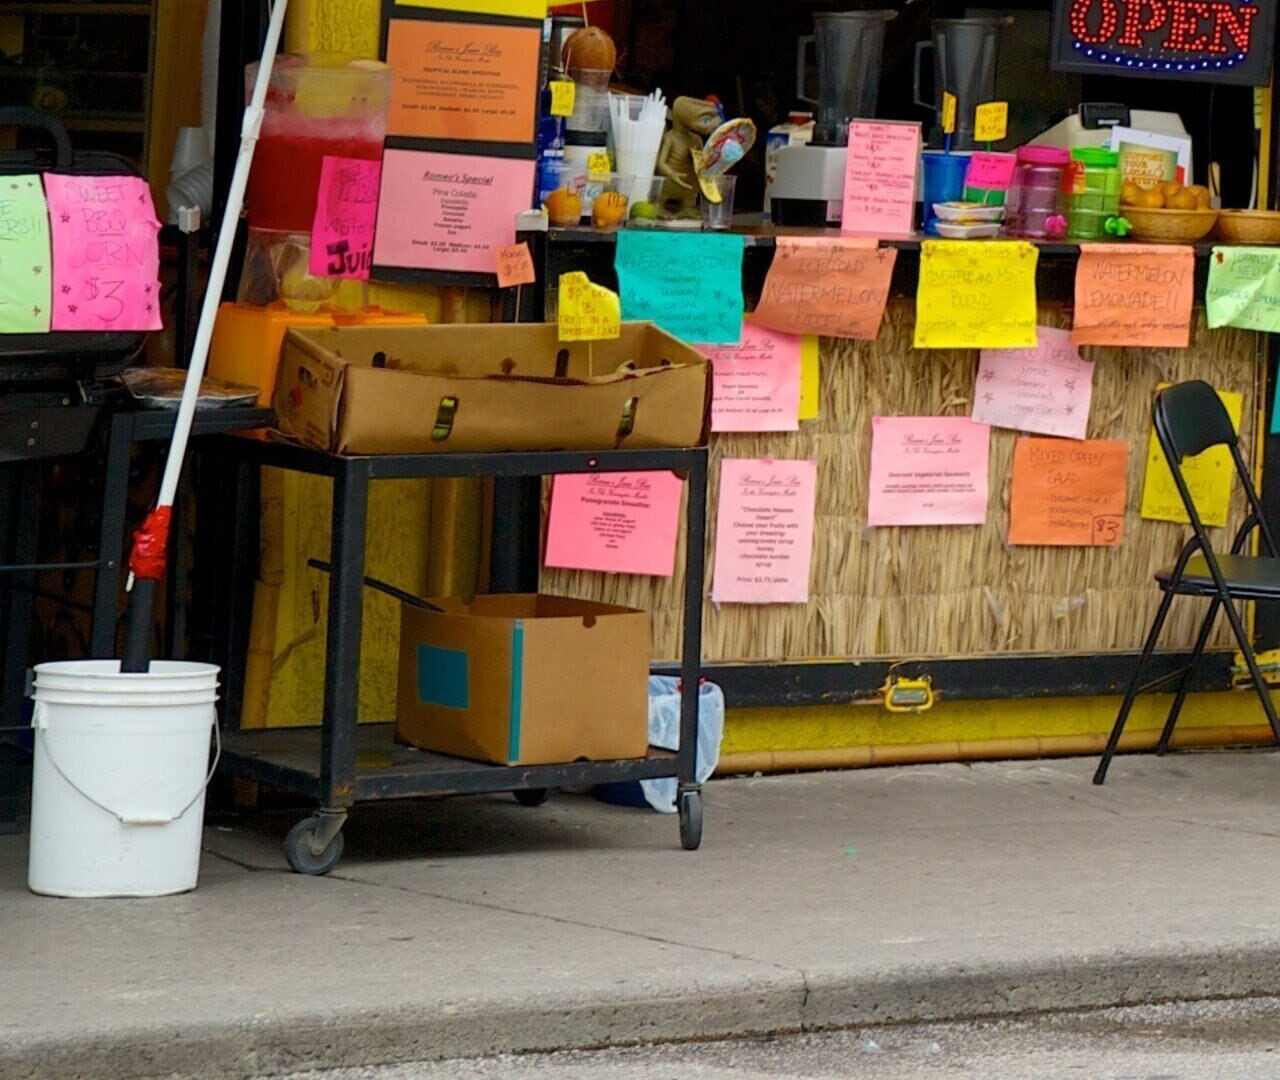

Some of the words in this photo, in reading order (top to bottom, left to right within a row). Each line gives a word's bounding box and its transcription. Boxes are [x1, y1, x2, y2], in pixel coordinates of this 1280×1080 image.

[422, 170, 460, 185] Romeo's
[459, 172, 494, 187] Special
[65, 182, 129, 205] SWEET
[451, 189, 477, 199] Colada
[1092, 262, 1187, 287] WATERMELON
[84, 277, 125, 322] $3
[766, 281, 887, 306] WATERMELON
[1029, 445, 1066, 466] MIXED
[1069, 448, 1105, 465] GREEN
[1046, 469, 1081, 488] SALAD
[1094, 517, 1121, 543] $3
[776, 538, 794, 547] syrup
[755, 561, 772, 569] syrup
